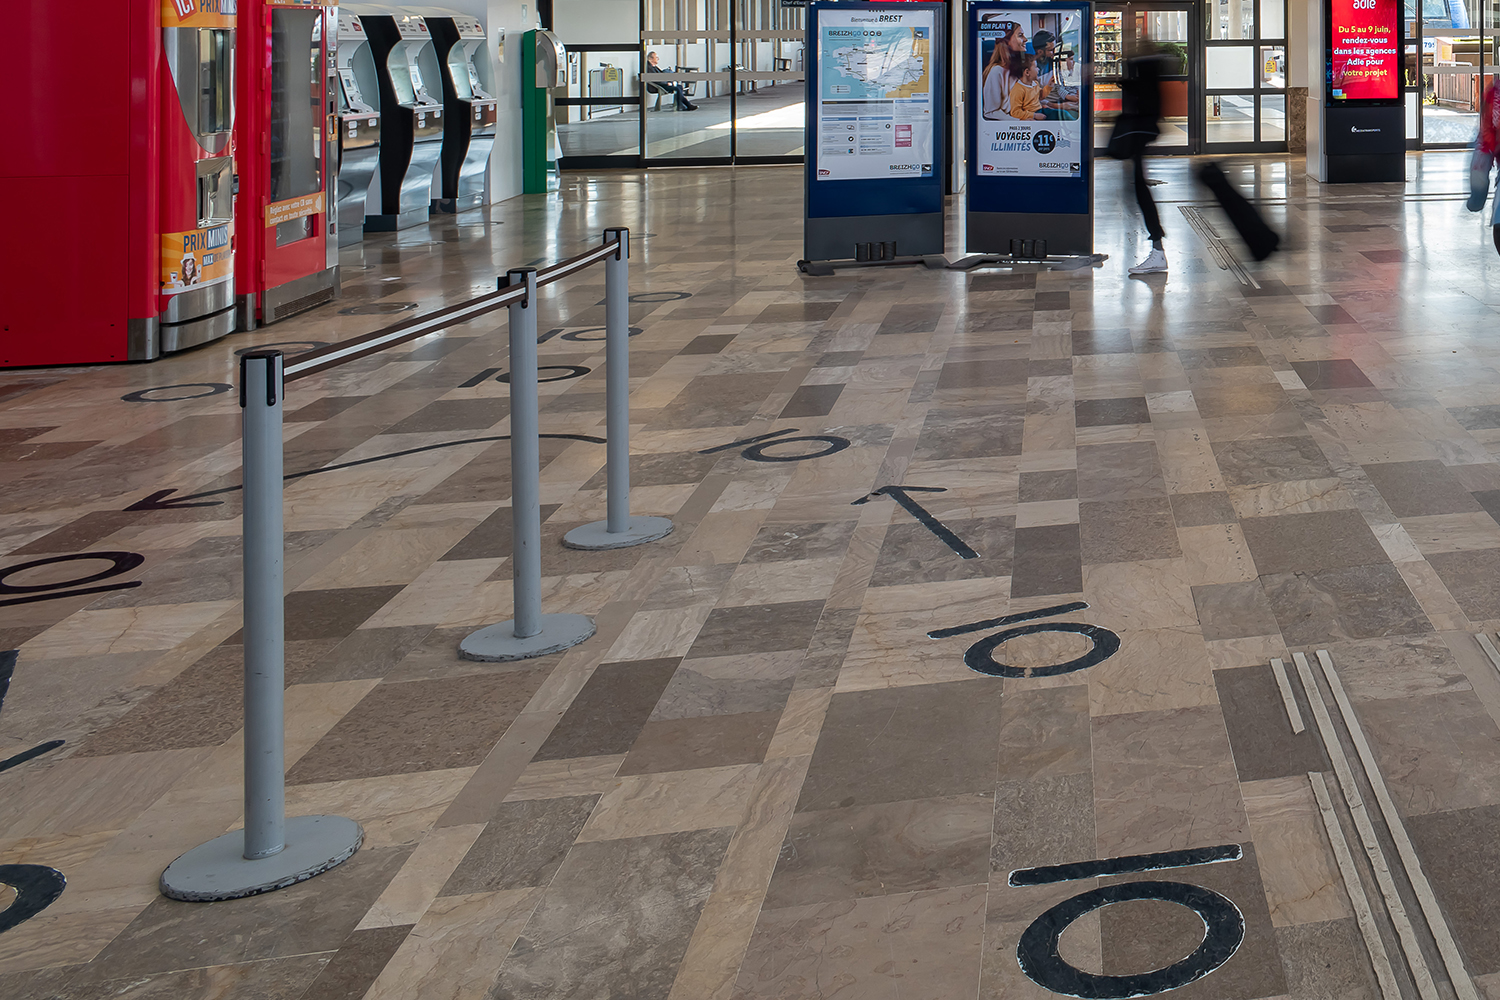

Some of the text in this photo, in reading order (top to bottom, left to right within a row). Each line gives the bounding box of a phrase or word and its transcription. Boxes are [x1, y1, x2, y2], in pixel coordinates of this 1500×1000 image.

[879, 15, 903, 23] BREST
[1374, 26, 1391, 34] juin,
[1334, 47, 1352, 55] dans
[1353, 47, 1364, 55] les
[1347, 58, 1384, 67] Adie pour
[1365, 69, 1388, 77] projet
[996, 132, 1031, 141] VOYAGES
[991, 141, 1031, 151] ILLIMITÉS
[183, 226, 228, 253] PRIX MINIS
[203, 254, 213, 265] MAX
